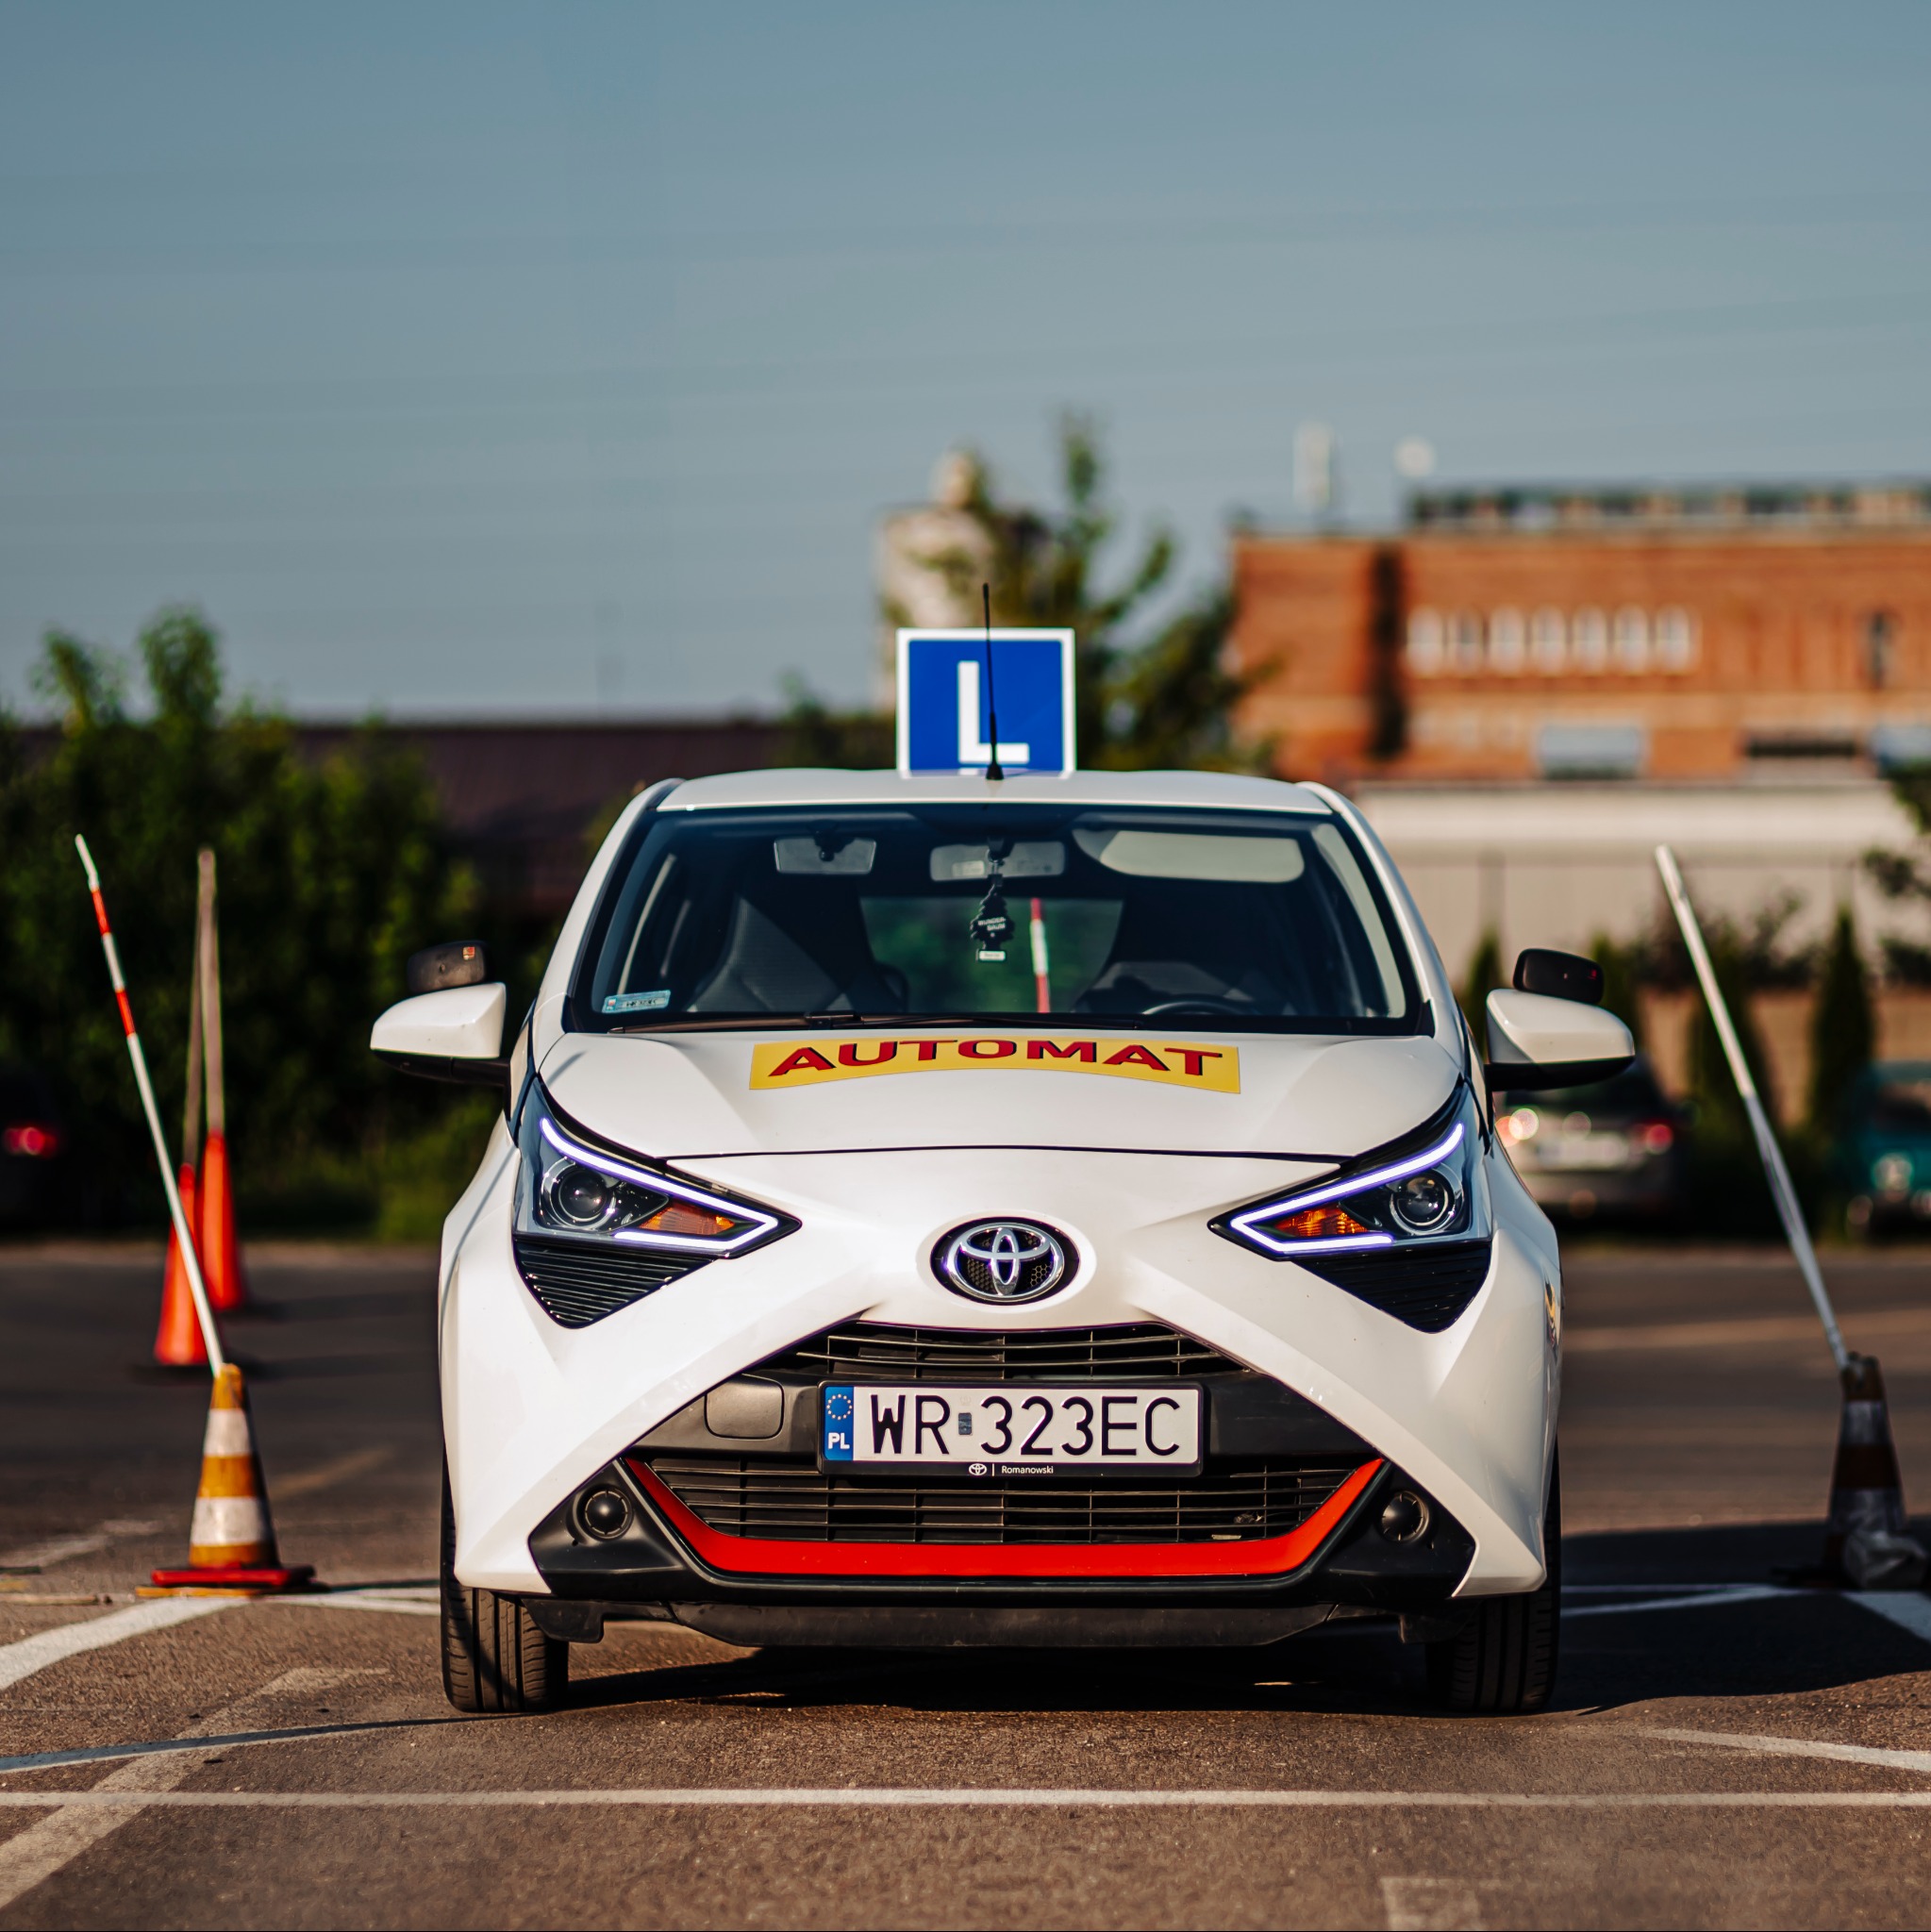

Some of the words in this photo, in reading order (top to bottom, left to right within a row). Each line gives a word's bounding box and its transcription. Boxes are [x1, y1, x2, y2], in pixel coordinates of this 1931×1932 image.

[957, 661, 1029, 763] L
[768, 1039, 1224, 1076] AUTOMAT
[828, 1432, 850, 1449] PL
[870, 1394, 950, 1455] WR
[980, 1395, 1181, 1457] 323EC
[1001, 1465, 1054, 1474] Romanowski
